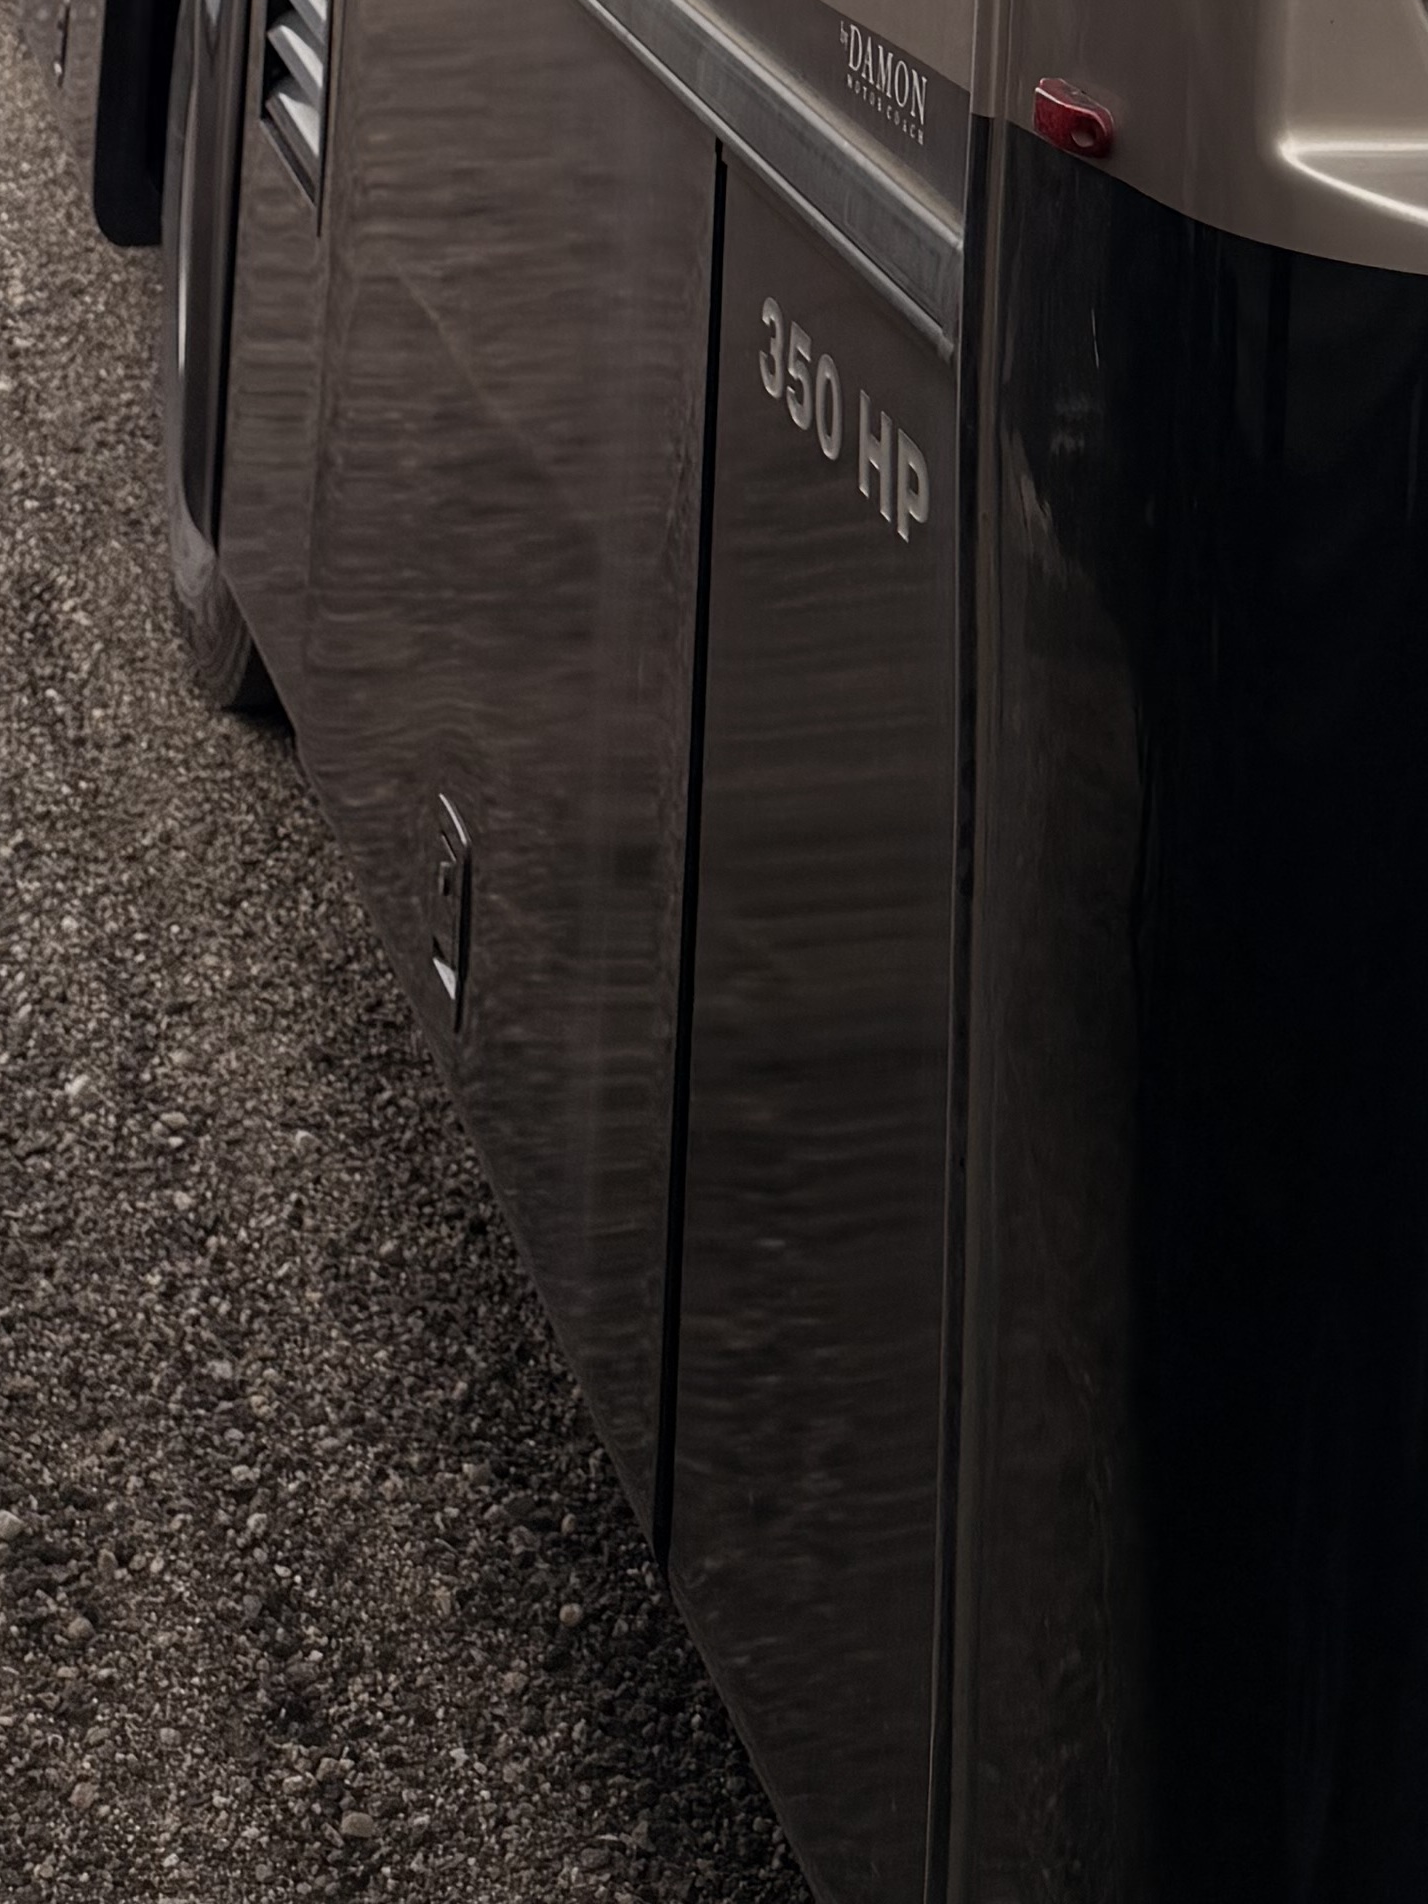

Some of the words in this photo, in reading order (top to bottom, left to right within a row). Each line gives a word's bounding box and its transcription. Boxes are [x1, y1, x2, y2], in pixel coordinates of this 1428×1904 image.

[848, 23, 928, 126] DAMON
[759, 296, 843, 462] 350
[858, 388, 930, 544] HP
